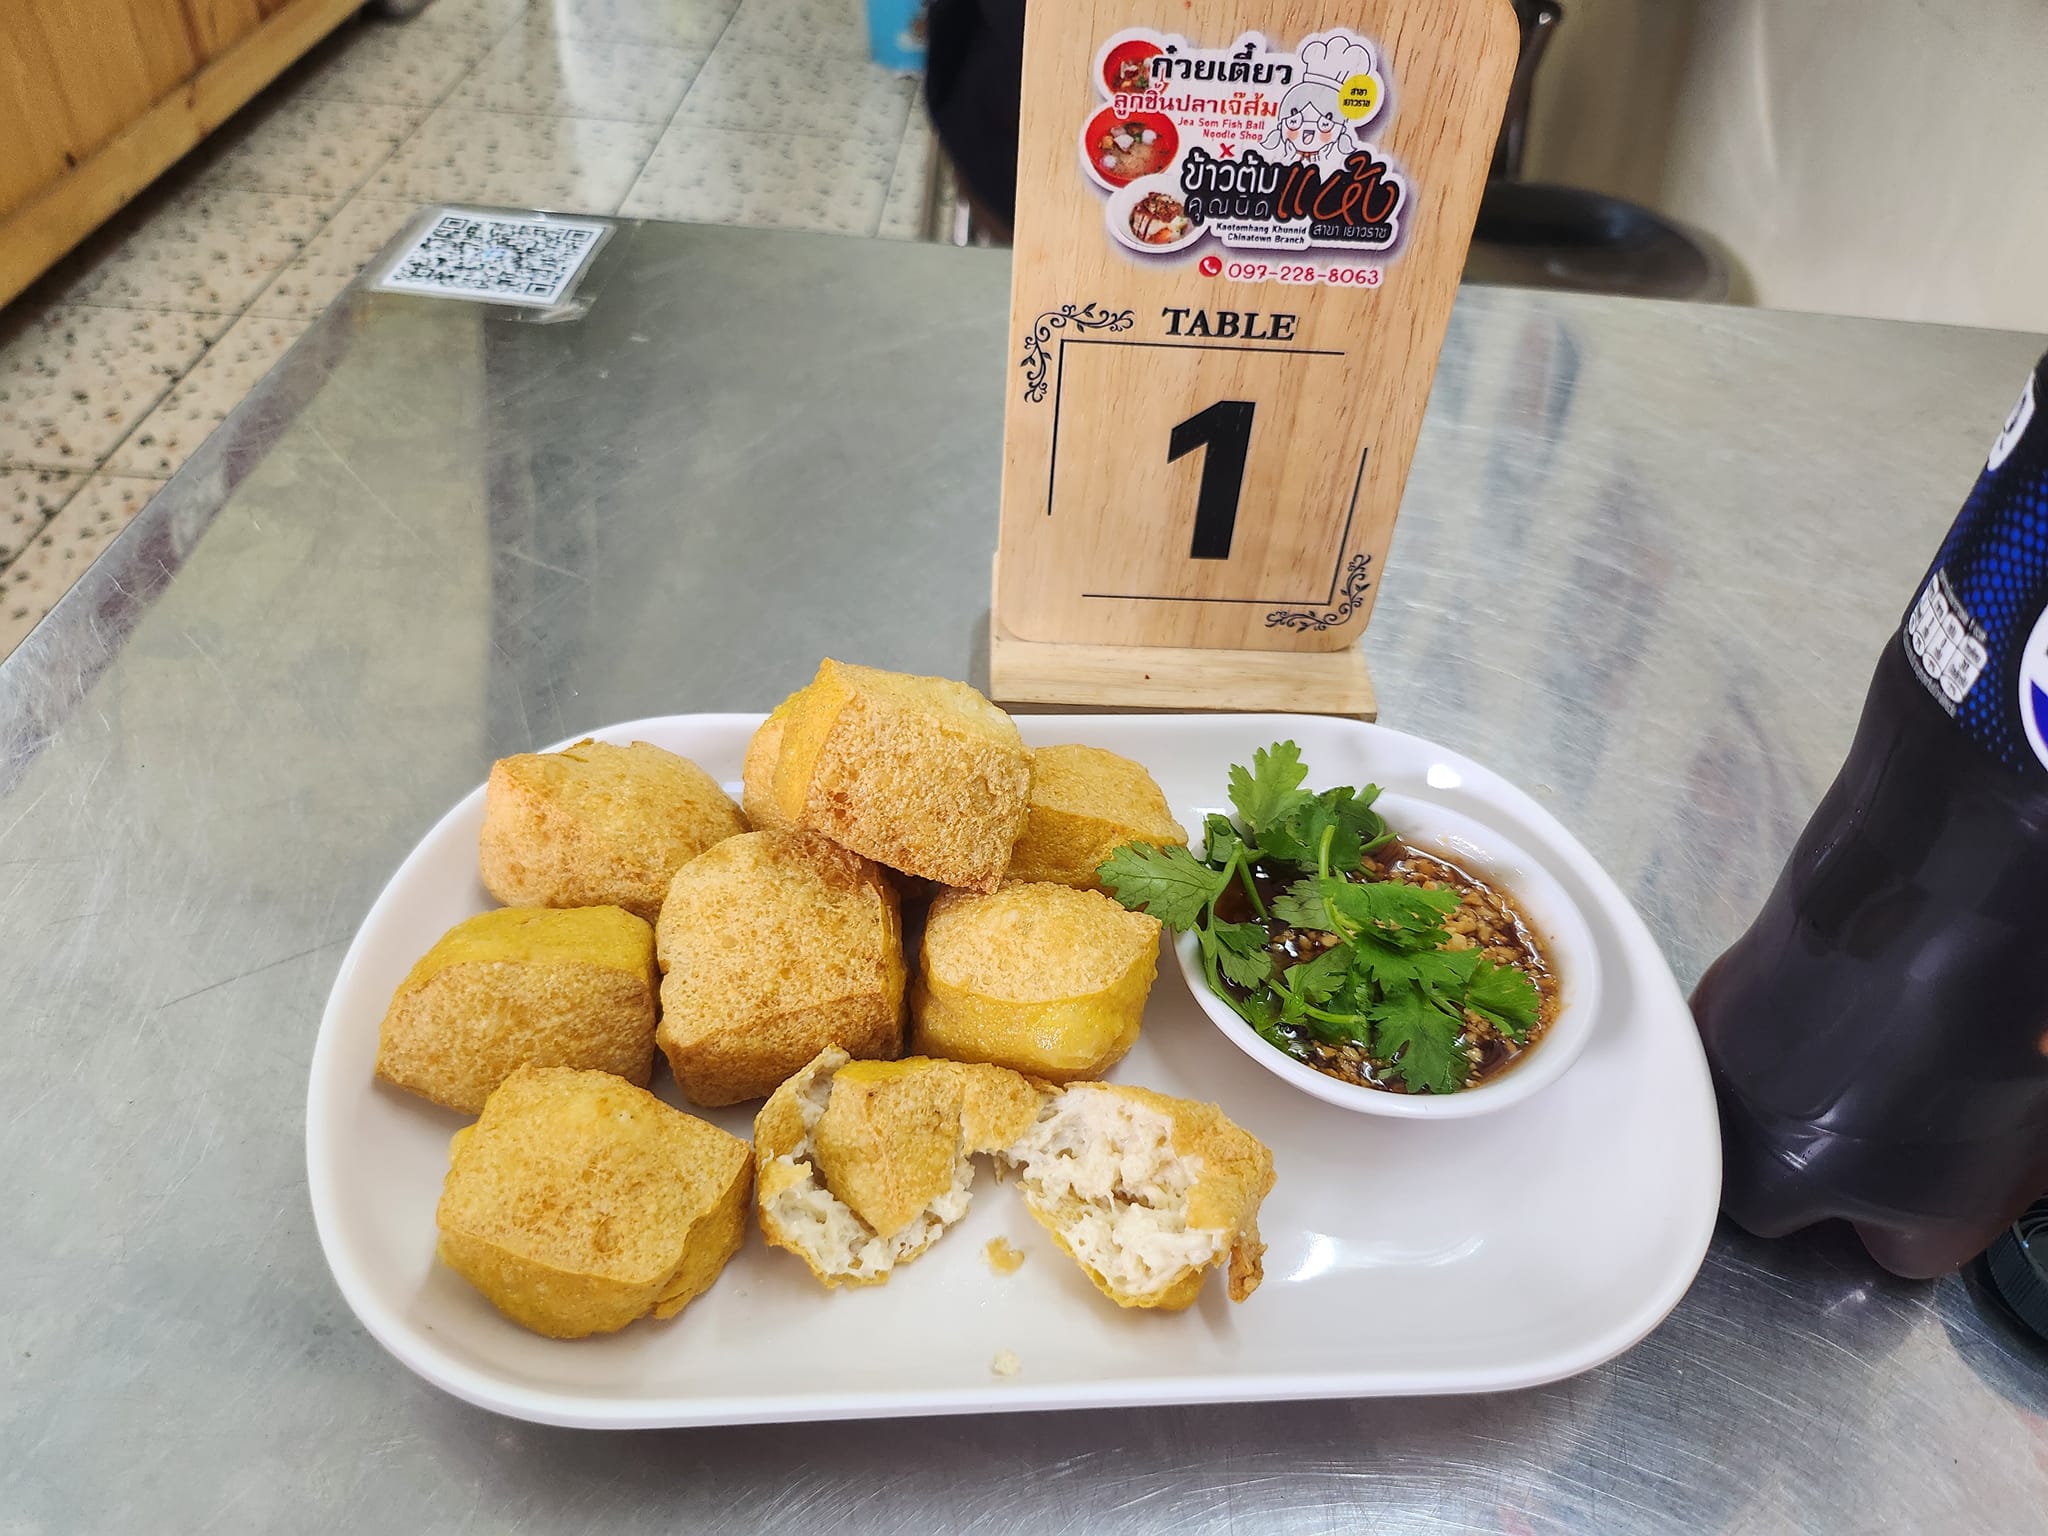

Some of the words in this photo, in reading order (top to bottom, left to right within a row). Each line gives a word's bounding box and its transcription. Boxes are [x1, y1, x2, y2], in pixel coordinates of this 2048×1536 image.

[1151, 42, 1293, 84] ก๋วยเตี๋ยว
[1113, 83, 1278, 116] ลูกชิ้นปลาเจ๊ส้ม
[1178, 117, 1194, 126] Jea
[1199, 118, 1218, 127] Som
[1223, 119, 1242, 129] Fish
[1246, 120, 1265, 130] Ball
[1203, 130, 1236, 139] Noodle
[1240, 131, 1263, 141] Shop
[1185, 152, 1279, 194] ข้าวต้ม
[1216, 223, 1269, 234] Kaotomhang
[1272, 225, 1307, 234] Khunnid
[1228, 233, 1272, 242] Chinatown
[1275, 235, 1304, 244] Branch
[1313, 224, 1339, 236] สาขา
[1343, 226, 1388, 238] เยาวราช
[1228, 263, 1379, 285] 097-228-8063
[1161, 307, 1296, 341] TABLE
[1167, 400, 1256, 560] 1
